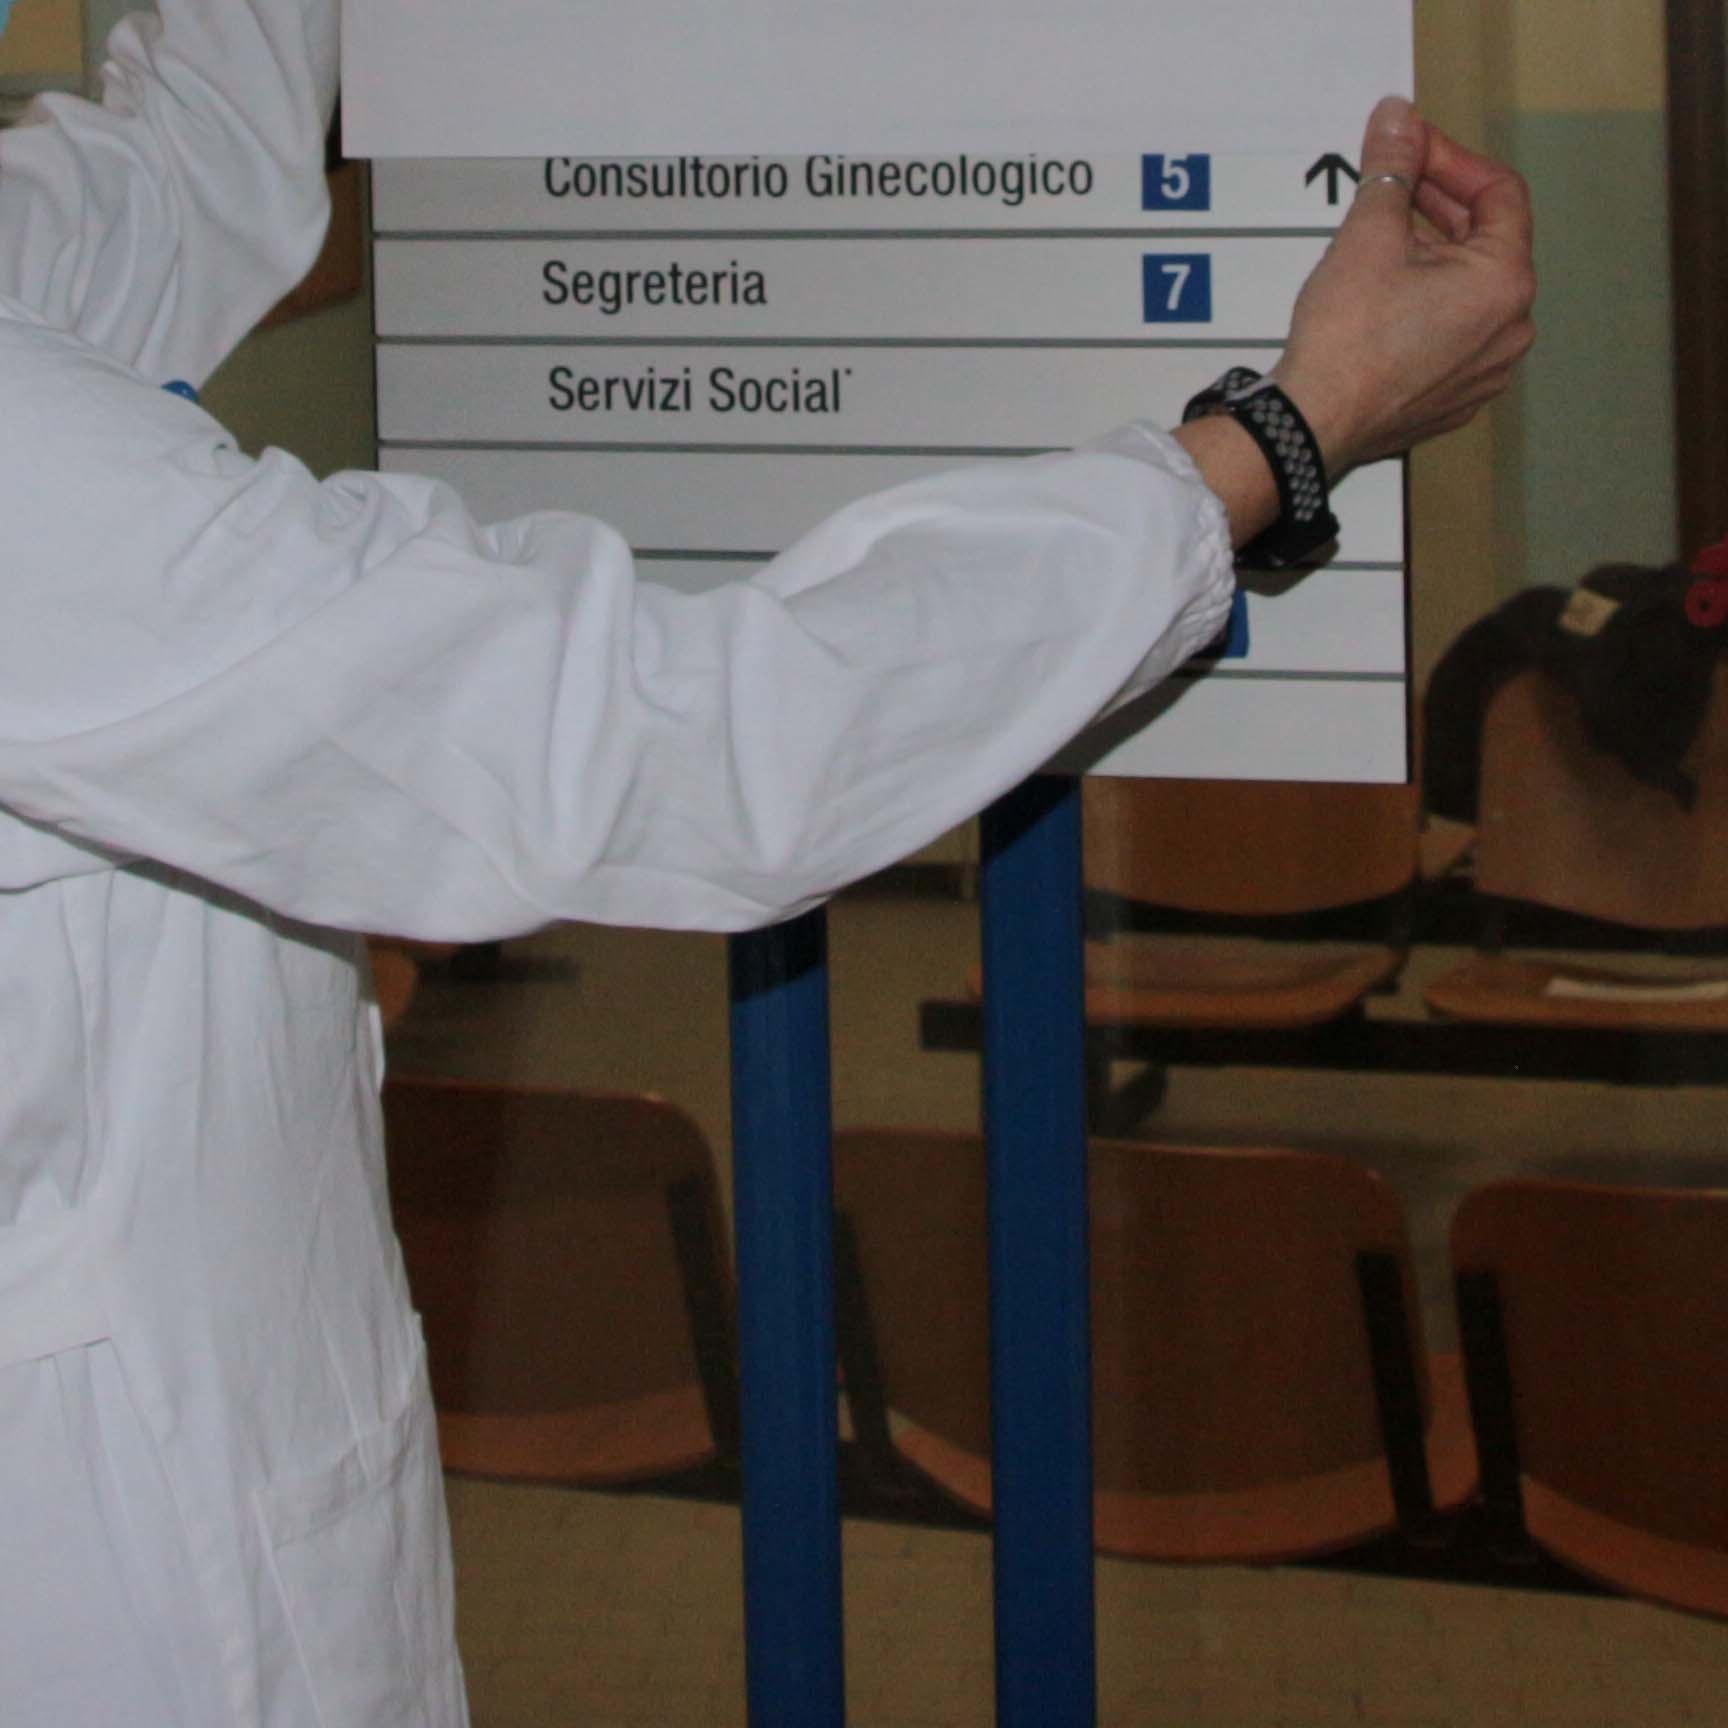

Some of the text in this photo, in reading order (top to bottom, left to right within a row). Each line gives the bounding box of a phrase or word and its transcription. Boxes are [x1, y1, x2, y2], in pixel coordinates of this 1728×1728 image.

[544, 154, 1192, 206] Consultorio Ginecologico 5
[541, 259, 1193, 315] Segreteria 7
[548, 365, 854, 415] Servizi Social
